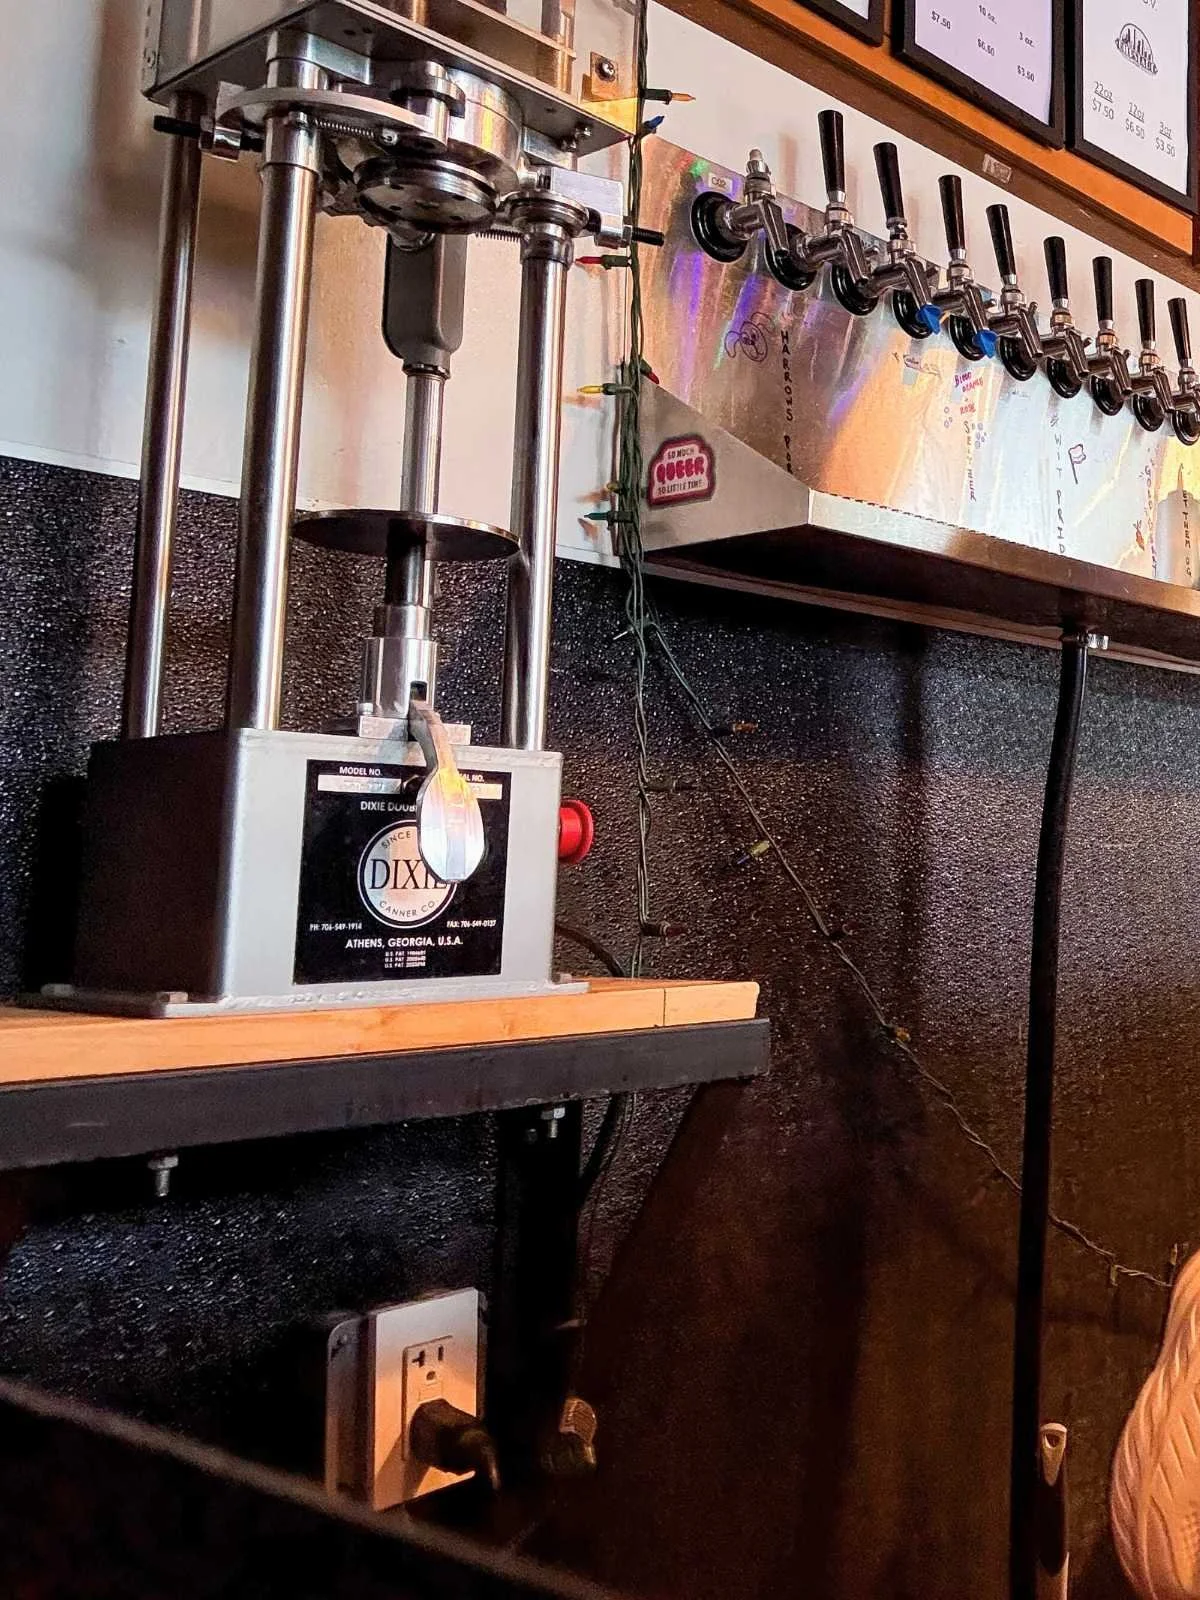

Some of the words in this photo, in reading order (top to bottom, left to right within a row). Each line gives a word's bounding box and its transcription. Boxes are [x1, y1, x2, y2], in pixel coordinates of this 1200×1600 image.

[931, 11, 951, 29] $7.50
[1094, 81, 1113, 103] 22oz
[656, 456, 705, 484] QUEER
[339, 766, 368, 776] MODEL
[360, 800, 386, 811] DIXIE
[388, 802, 418, 812] DOUB
[381, 830, 411, 848] SINCE
[380, 900, 417, 918] CANNER
[345, 938, 385, 948] ATHENS,
[438, 936, 464, 946] U.S.A.
